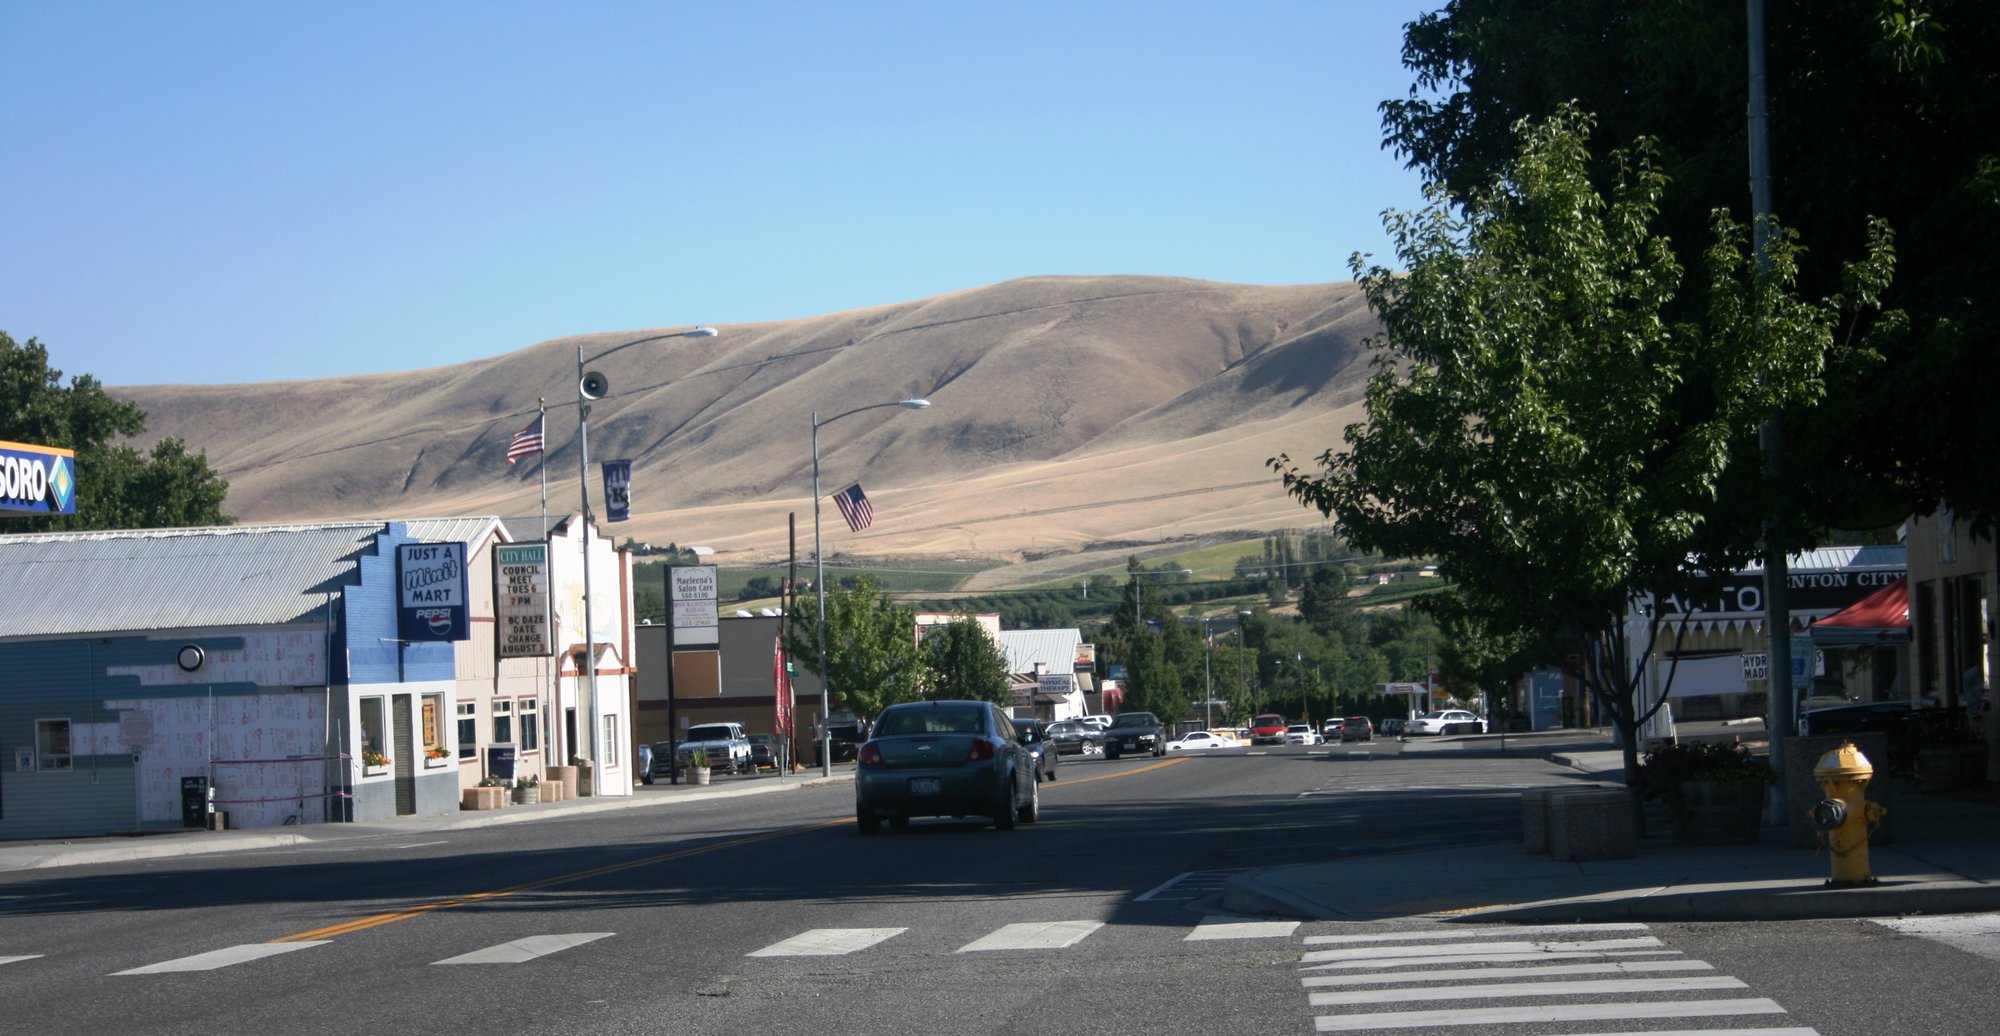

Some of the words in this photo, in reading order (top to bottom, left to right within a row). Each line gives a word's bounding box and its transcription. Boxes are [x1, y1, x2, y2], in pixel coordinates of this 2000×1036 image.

[408, 548, 438, 560] JUST
[443, 547, 453, 559] A
[500, 551, 520, 562] CITY
[521, 550, 544, 561] HALL
[503, 565, 540, 575] COUNCIL
[509, 576, 532, 584] MEET
[1857, 572, 1906, 586] CITY
[507, 585, 529, 594] TUES
[531, 584, 537, 593] 6
[678, 585, 697, 593] Salon
[698, 584, 713, 592] Care
[412, 589, 452, 602] MART
[415, 608, 452, 619] PEPSI
[508, 616, 520, 625] BC
[522, 615, 545, 624] DAZE
[513, 625, 536, 634] DATE
[508, 634, 541, 643] CHANGE
[502, 644, 537, 654] AUGUST
[539, 644, 545, 652] 3
